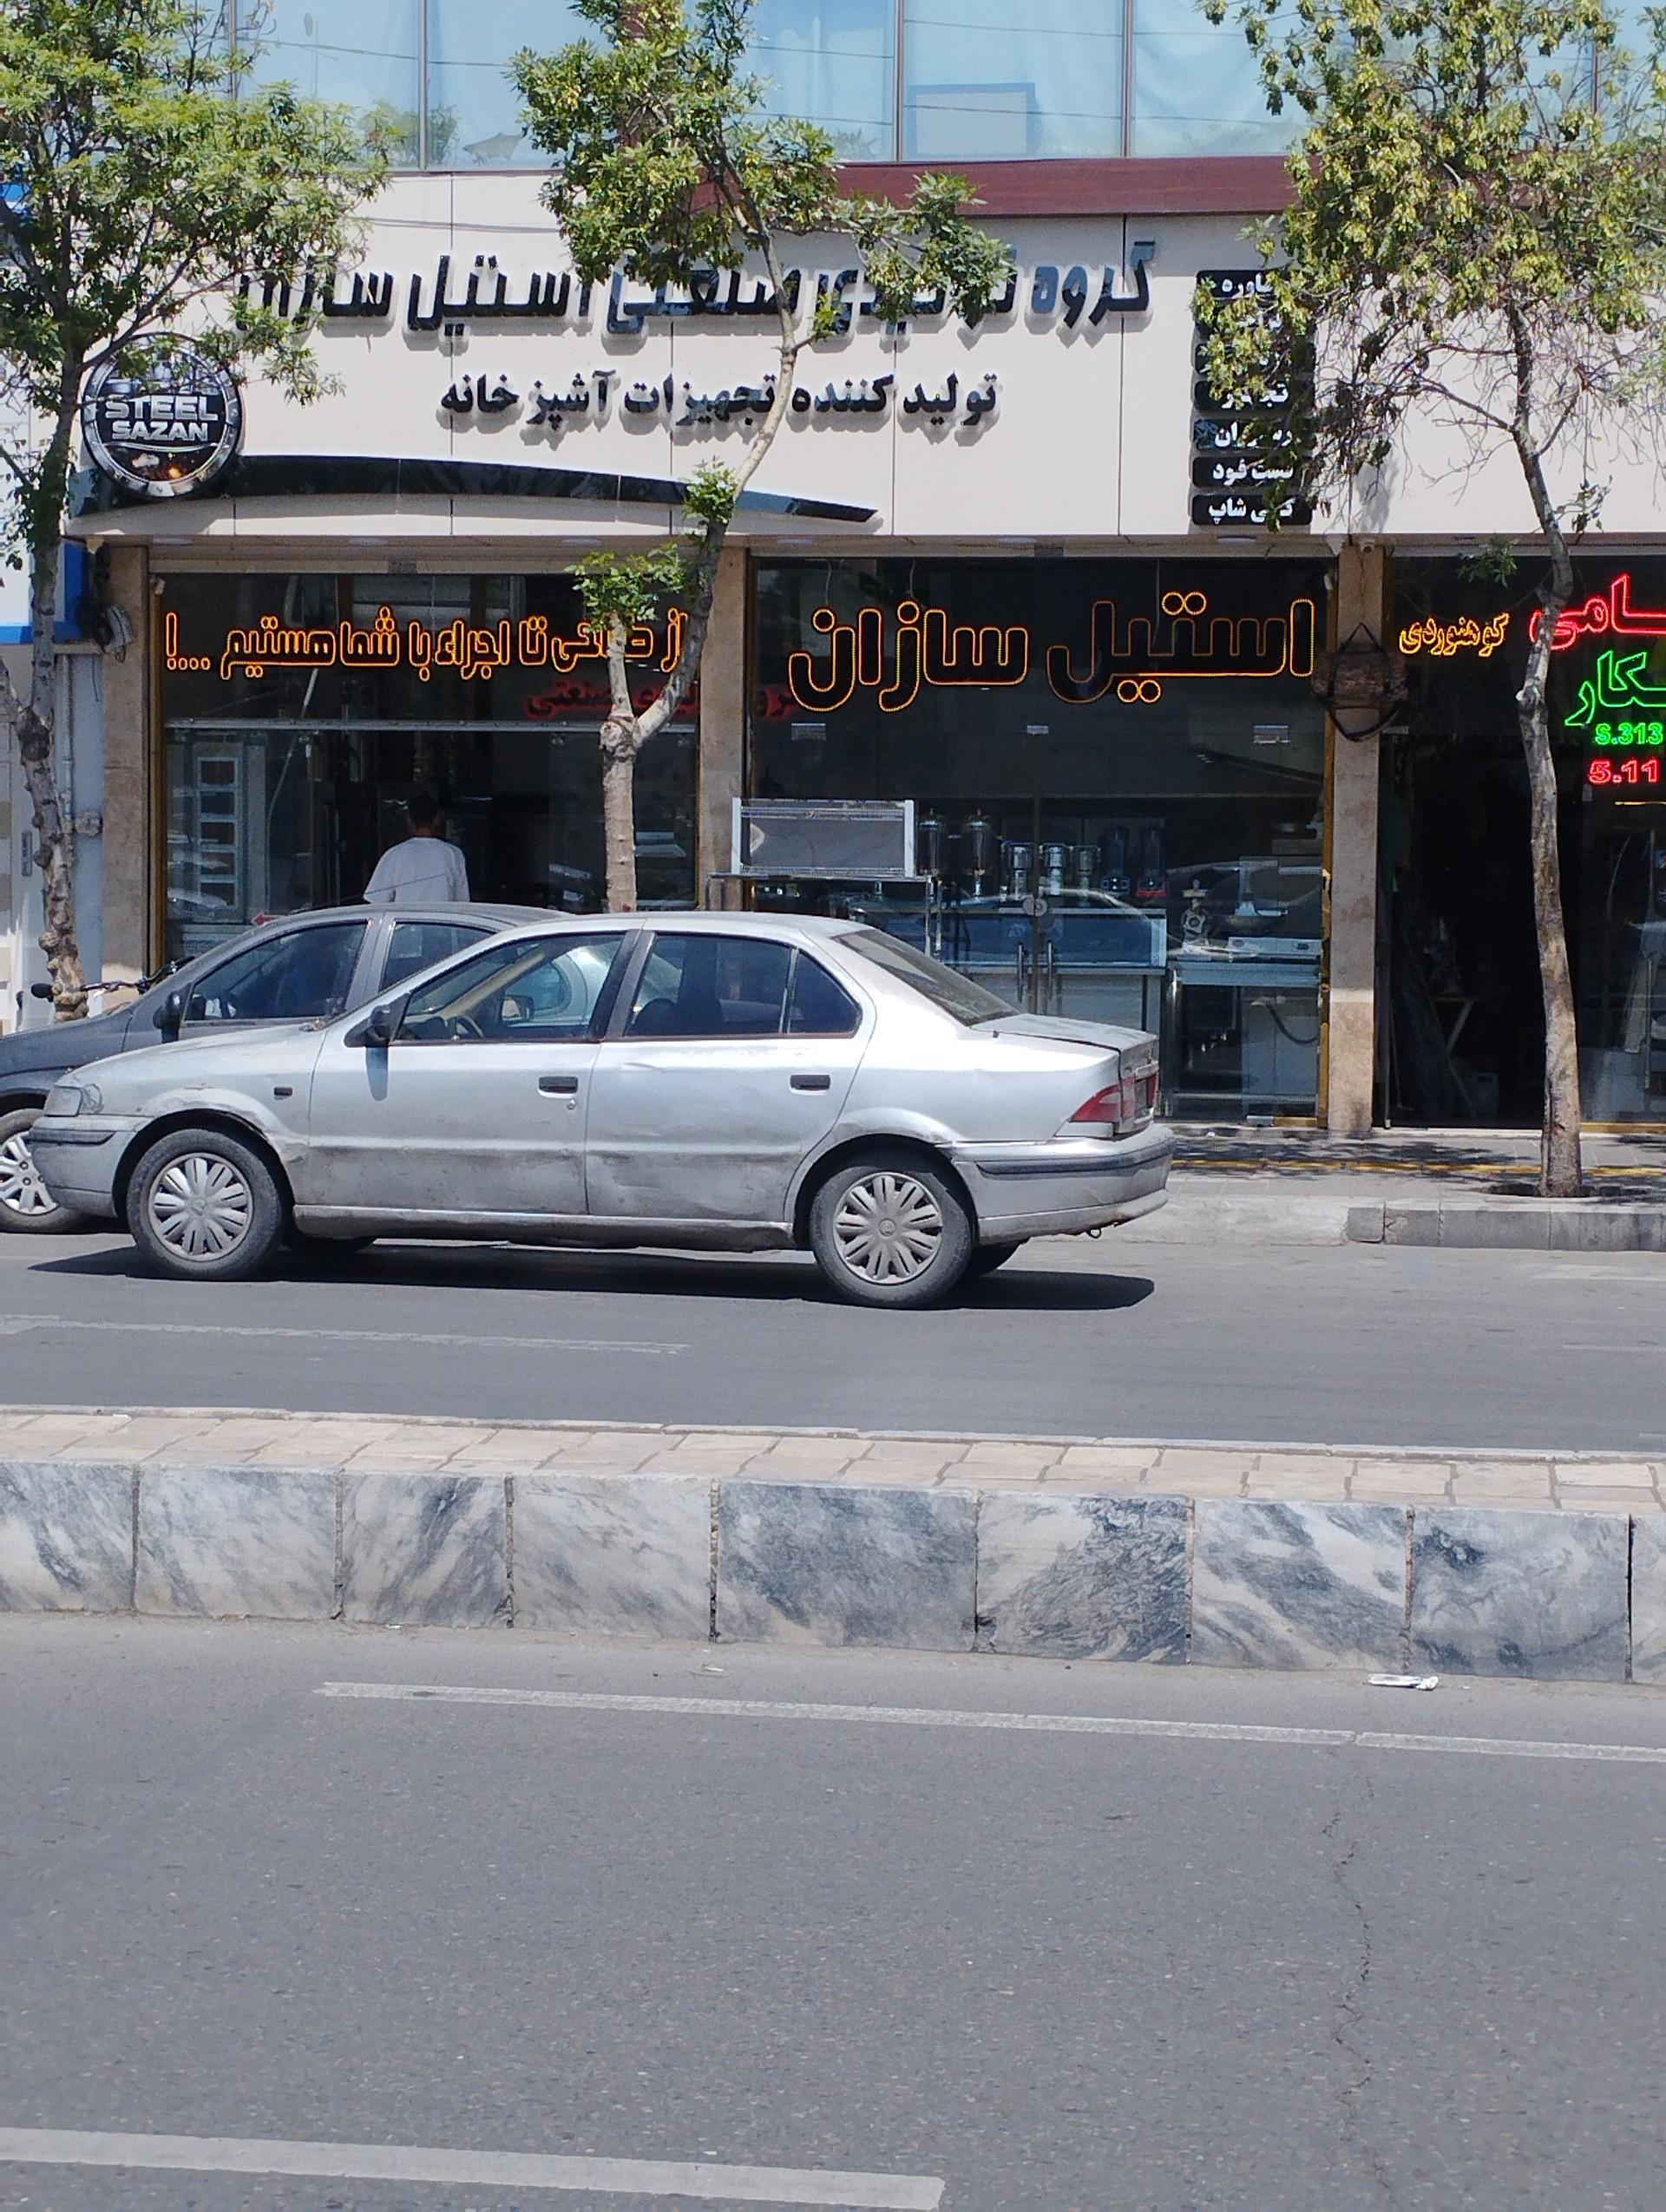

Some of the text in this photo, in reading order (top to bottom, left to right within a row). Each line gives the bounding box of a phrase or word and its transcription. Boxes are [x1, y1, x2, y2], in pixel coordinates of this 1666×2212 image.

[1032, 240, 1157, 330] گروه
[105, 395, 219, 422] STEEL
[791, 374, 895, 413] کننده
[903, 371, 998, 426] تولید
[112, 421, 209, 442] SAZAN
[220, 615, 337, 681] هستیم
[340, 605, 401, 667] شما
[409, 620, 431, 682] با
[519, 615, 548, 666] تا
[788, 591, 1315, 711] استیل سازان
[1589, 758, 1659, 785] 5.11
